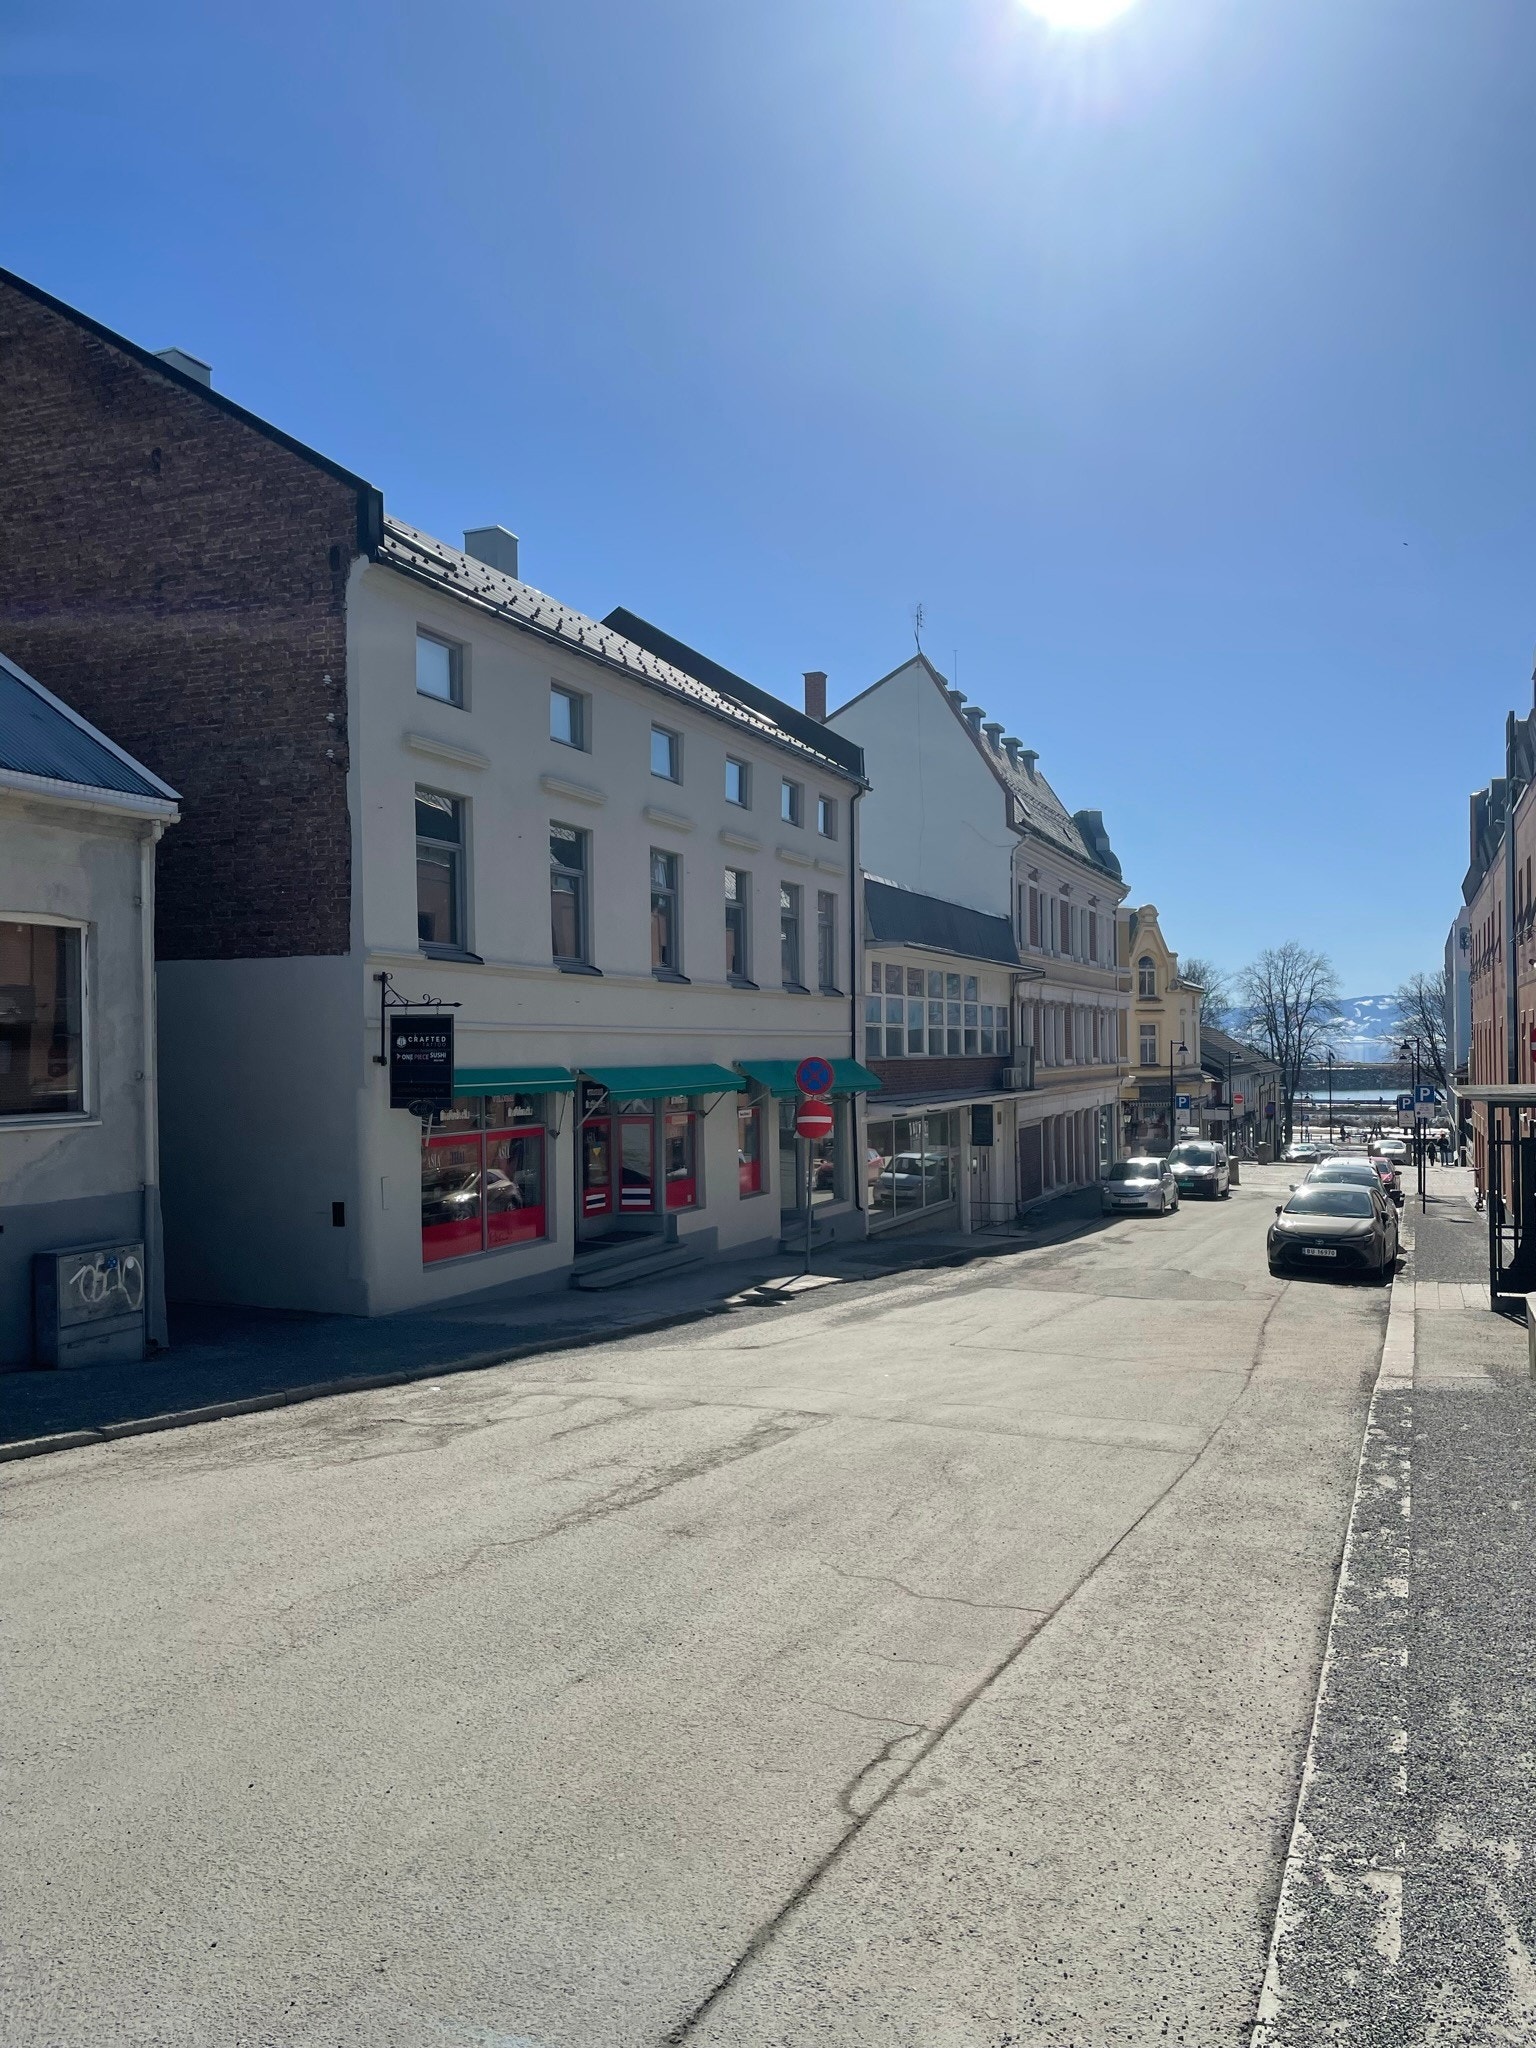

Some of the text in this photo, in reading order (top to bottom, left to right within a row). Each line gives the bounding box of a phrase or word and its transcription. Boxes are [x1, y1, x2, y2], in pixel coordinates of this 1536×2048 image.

[401, 1053, 413, 1061] ONE
[1420, 1087, 1431, 1102] P
[1178, 1096, 1187, 1108] P
[1402, 1097, 1411, 1109] P
